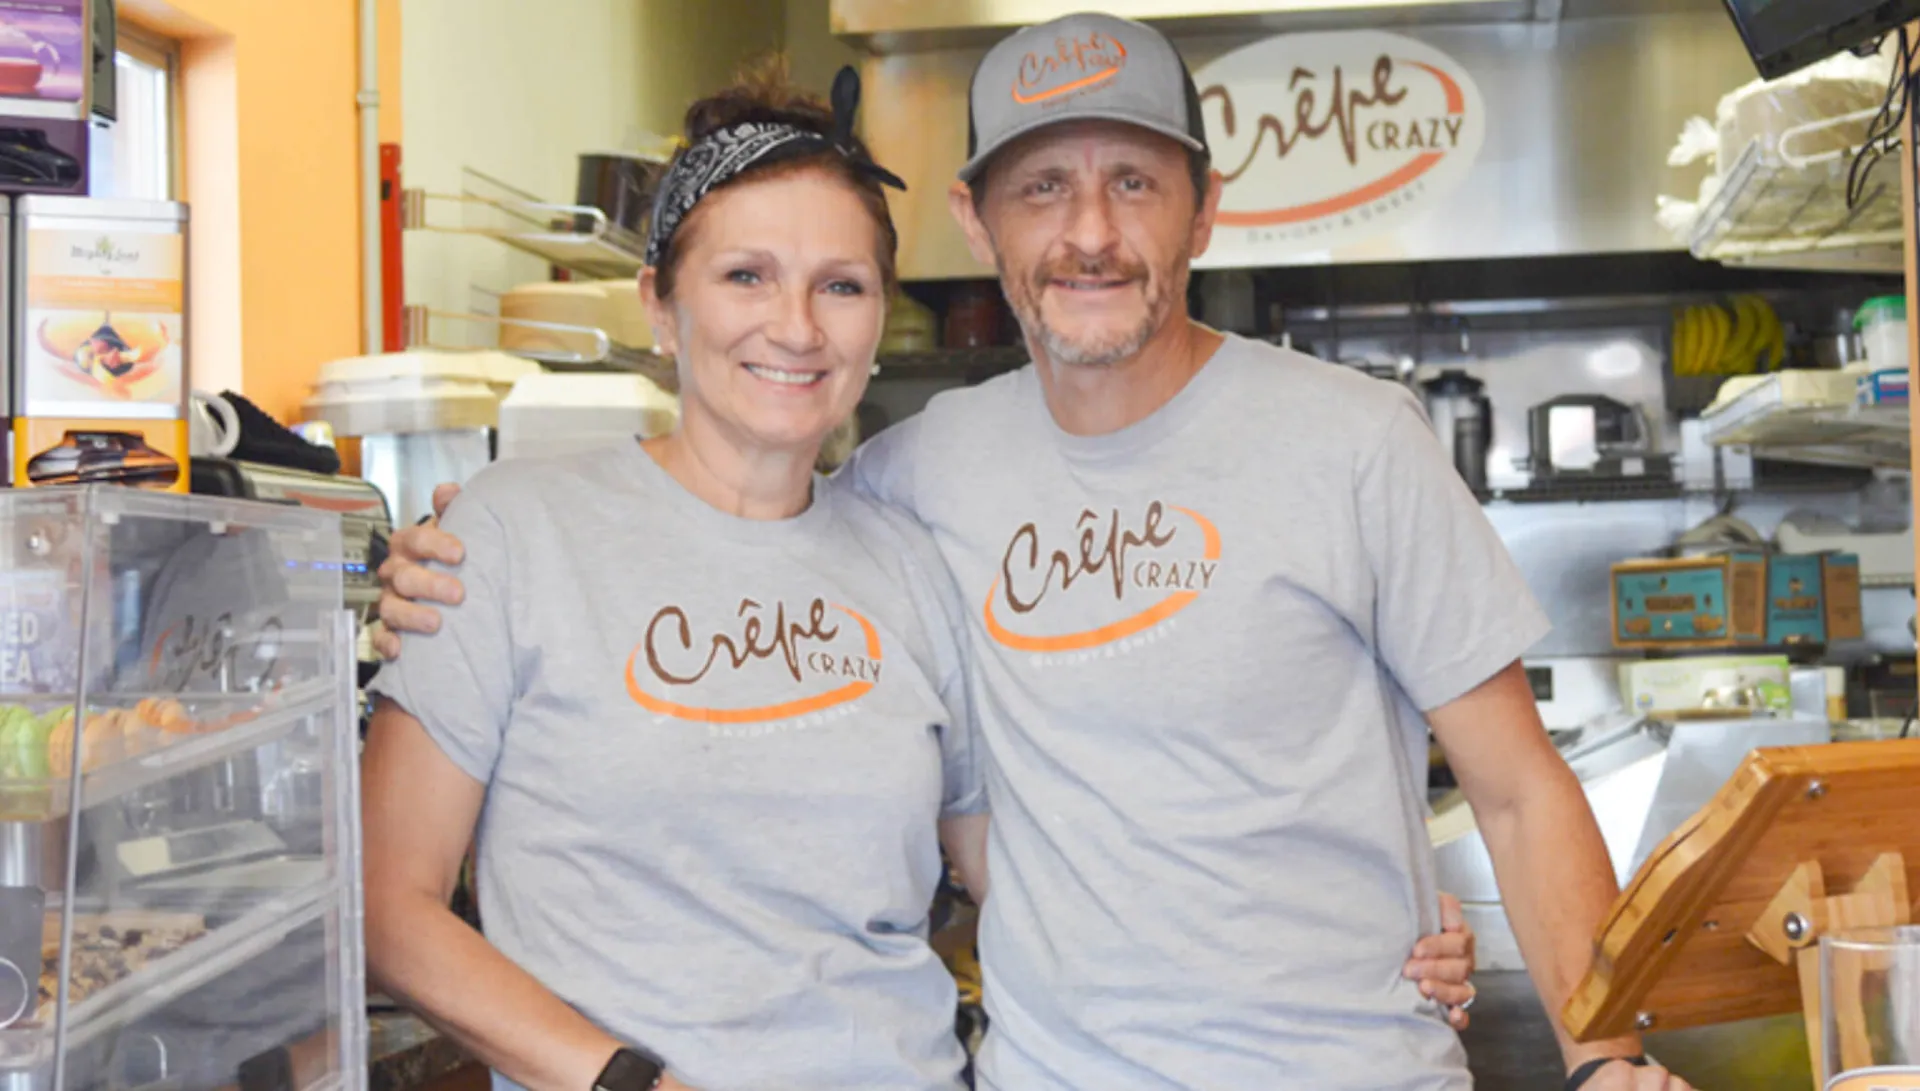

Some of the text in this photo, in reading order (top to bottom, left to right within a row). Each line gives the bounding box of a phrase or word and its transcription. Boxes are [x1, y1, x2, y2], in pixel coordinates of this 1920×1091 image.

[1366, 116, 1463, 150] CRAZY
[1003, 500, 1176, 614] Crêpe
[1133, 560, 1217, 589] CRAZY
[644, 598, 839, 685] Crêpe
[807, 651, 882, 683] CRAZY
